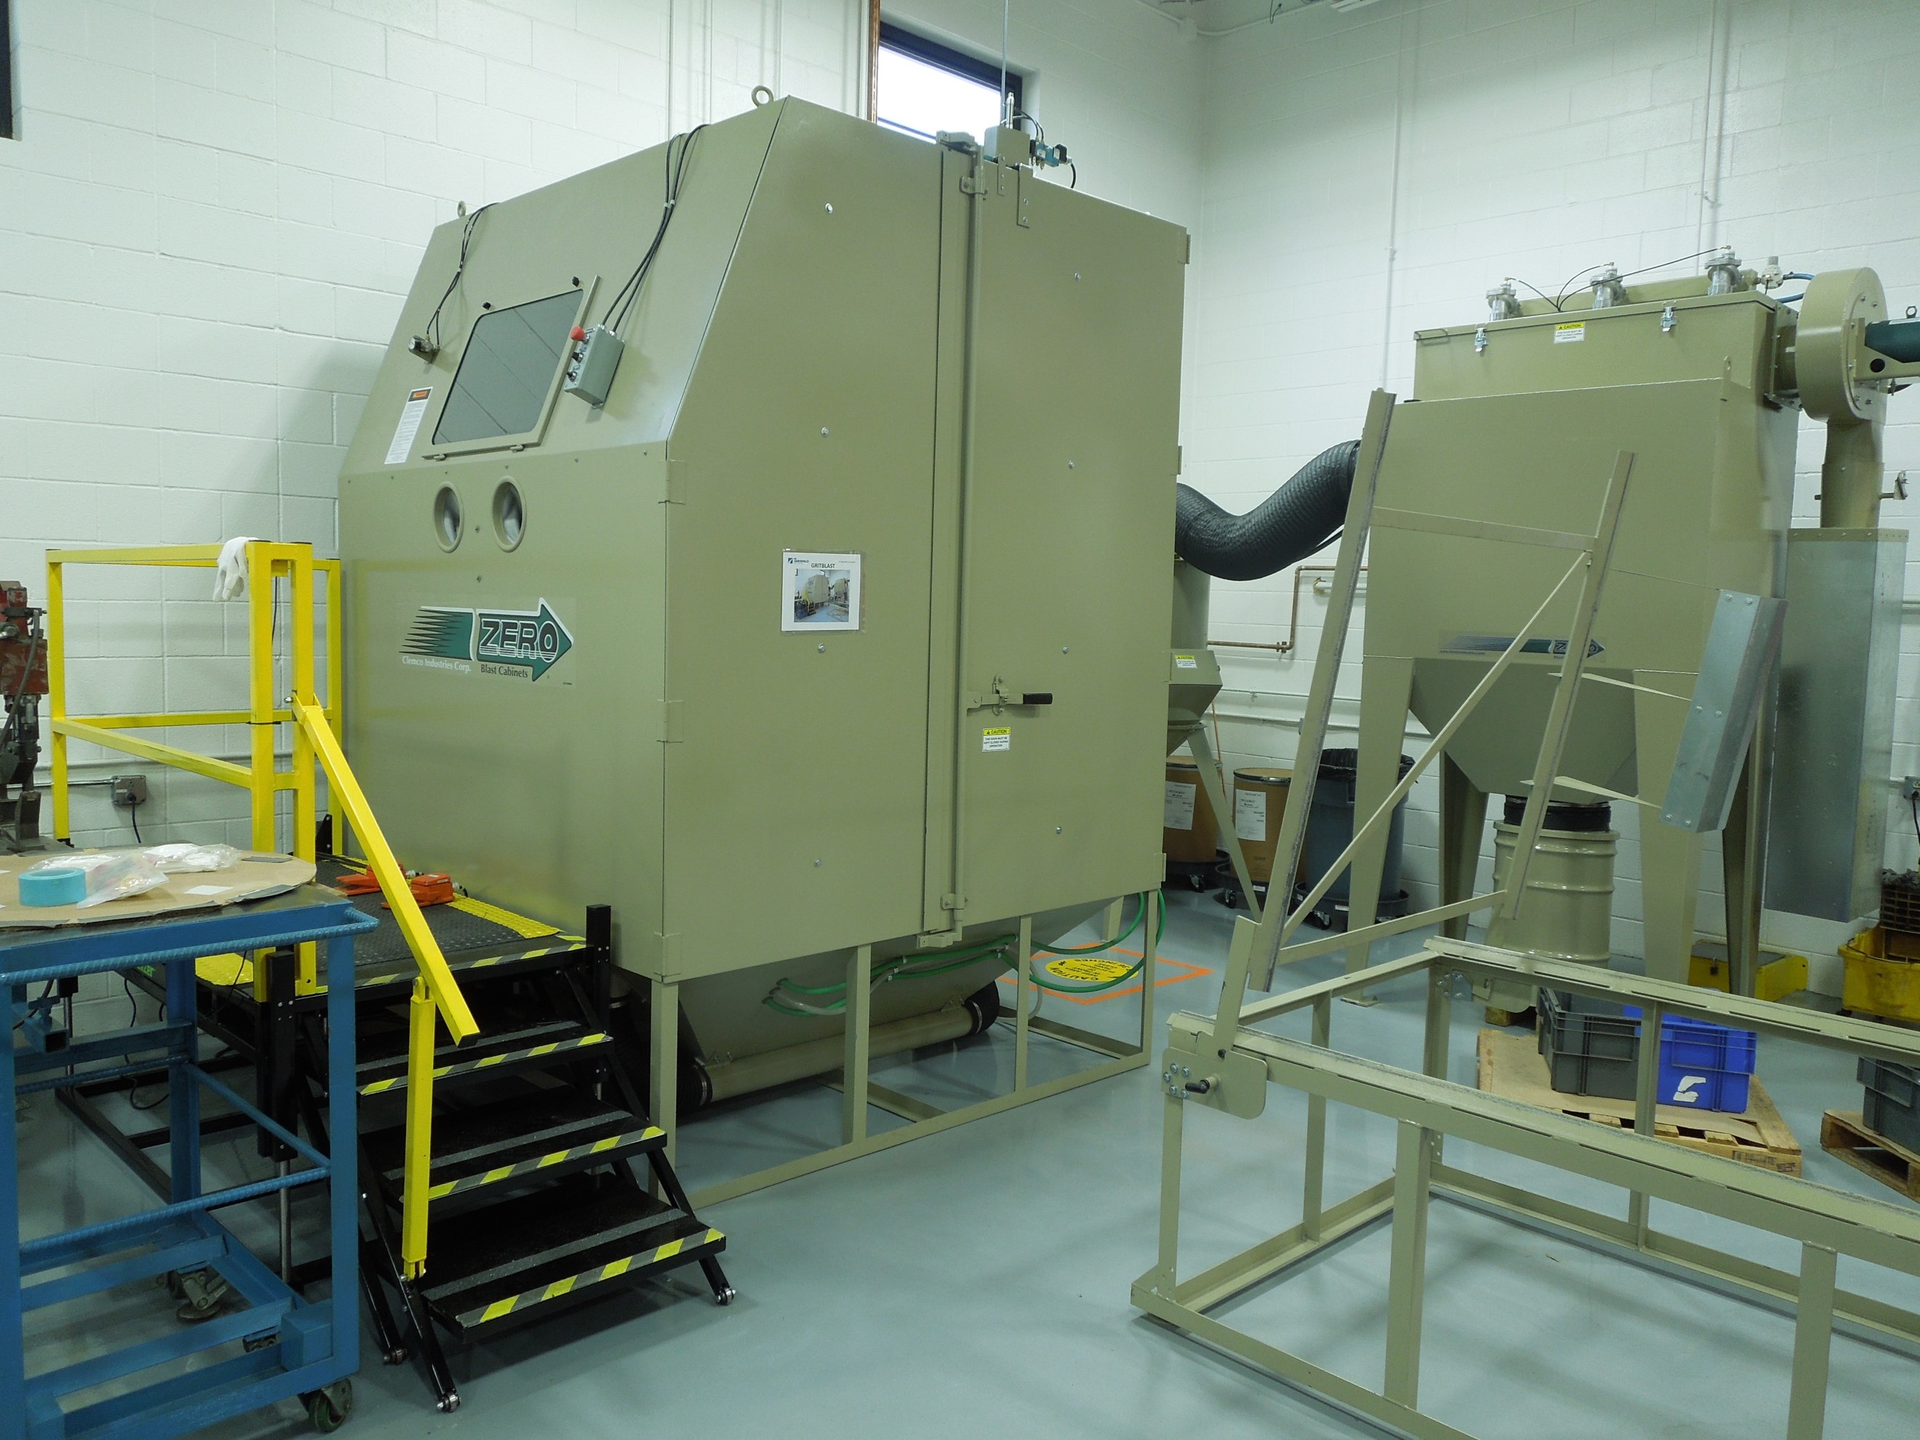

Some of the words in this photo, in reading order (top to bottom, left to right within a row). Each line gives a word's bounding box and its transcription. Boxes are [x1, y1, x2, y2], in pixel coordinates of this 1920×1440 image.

[479, 619, 559, 663] ZERO
[402, 656, 424, 666] Clemco
[424, 658, 453, 669] Industries
[454, 662, 471, 673] Corp.
[480, 664, 497, 674] Blast
[498, 665, 528, 678] Cabinets
